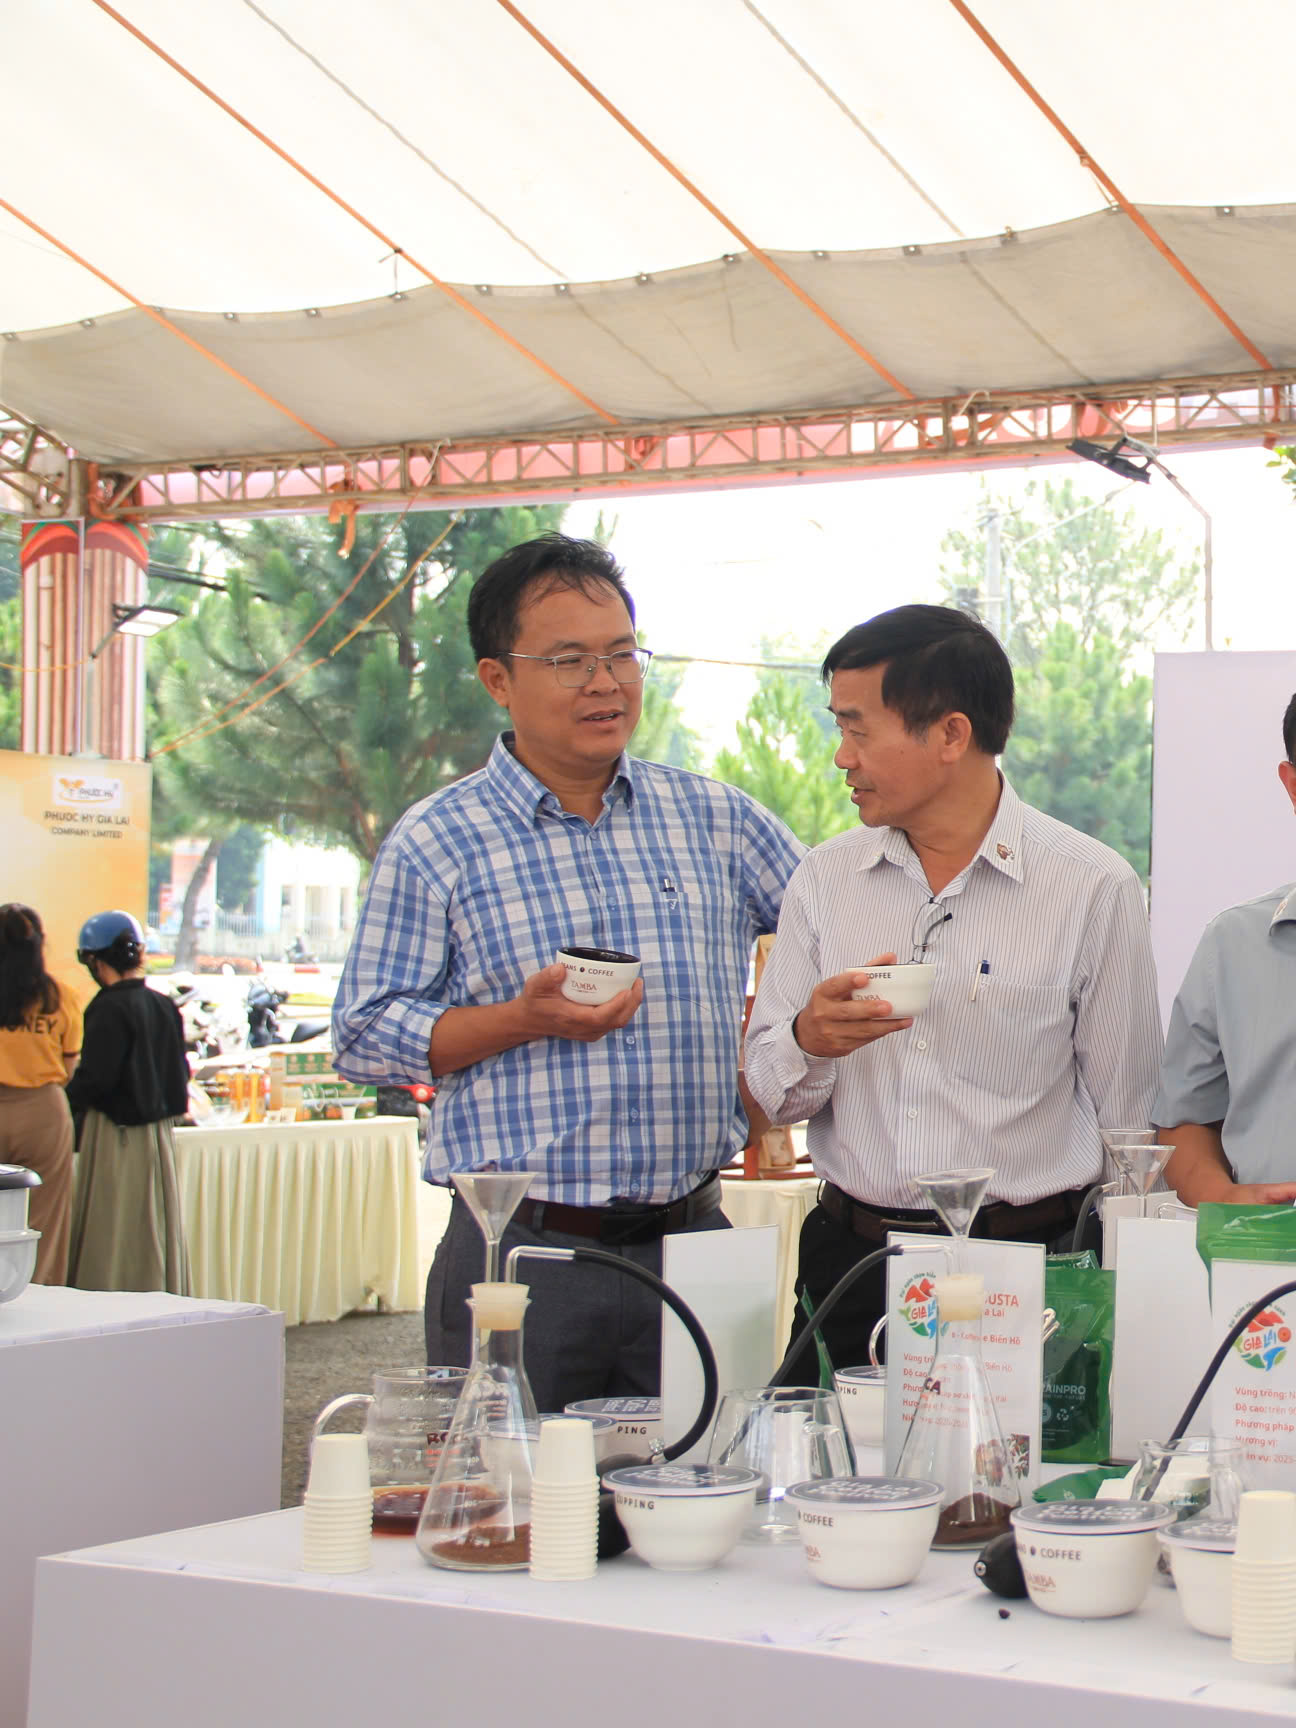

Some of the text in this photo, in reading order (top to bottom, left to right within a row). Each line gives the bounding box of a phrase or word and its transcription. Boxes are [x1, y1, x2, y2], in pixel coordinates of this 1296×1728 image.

[588, 968, 615, 977] COFFEE
[984, 1293, 1019, 1308] USTA
[911, 1305, 927, 1320] GIA
[1243, 1336, 1262, 1352] GIA
[1042, 1384, 1087, 1395] AINPRO
[1235, 1387, 1258, 1399] Vùng
[1235, 1402, 1248, 1413] Độ
[1235, 1418, 1270, 1431] Phương
[1272, 1422, 1295, 1433] pháp
[803, 1512, 834, 1528] COFFEE
[1041, 1547, 1081, 1561] COFFEE
